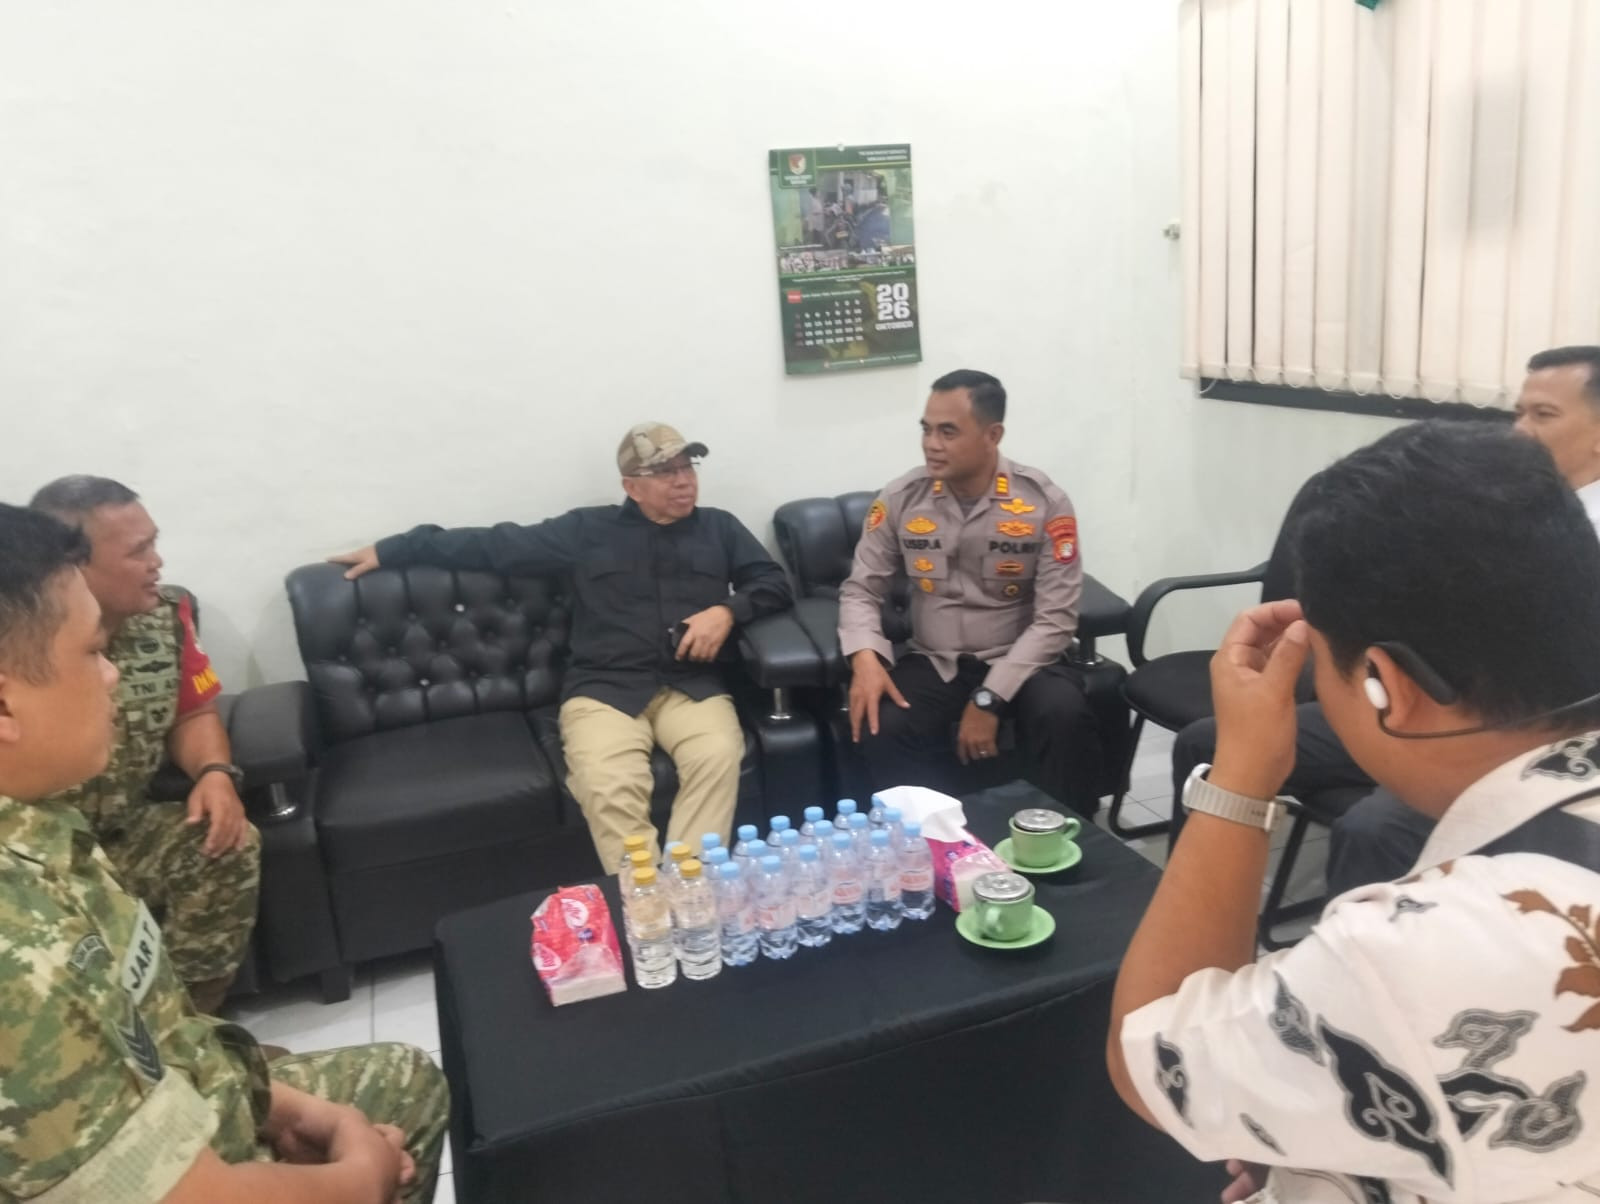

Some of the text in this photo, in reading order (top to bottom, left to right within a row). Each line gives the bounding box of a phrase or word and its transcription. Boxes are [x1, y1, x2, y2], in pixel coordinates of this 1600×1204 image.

[876, 283, 909, 302] 20
[877, 300, 910, 320] 26
[129, 680, 157, 697] TNI
